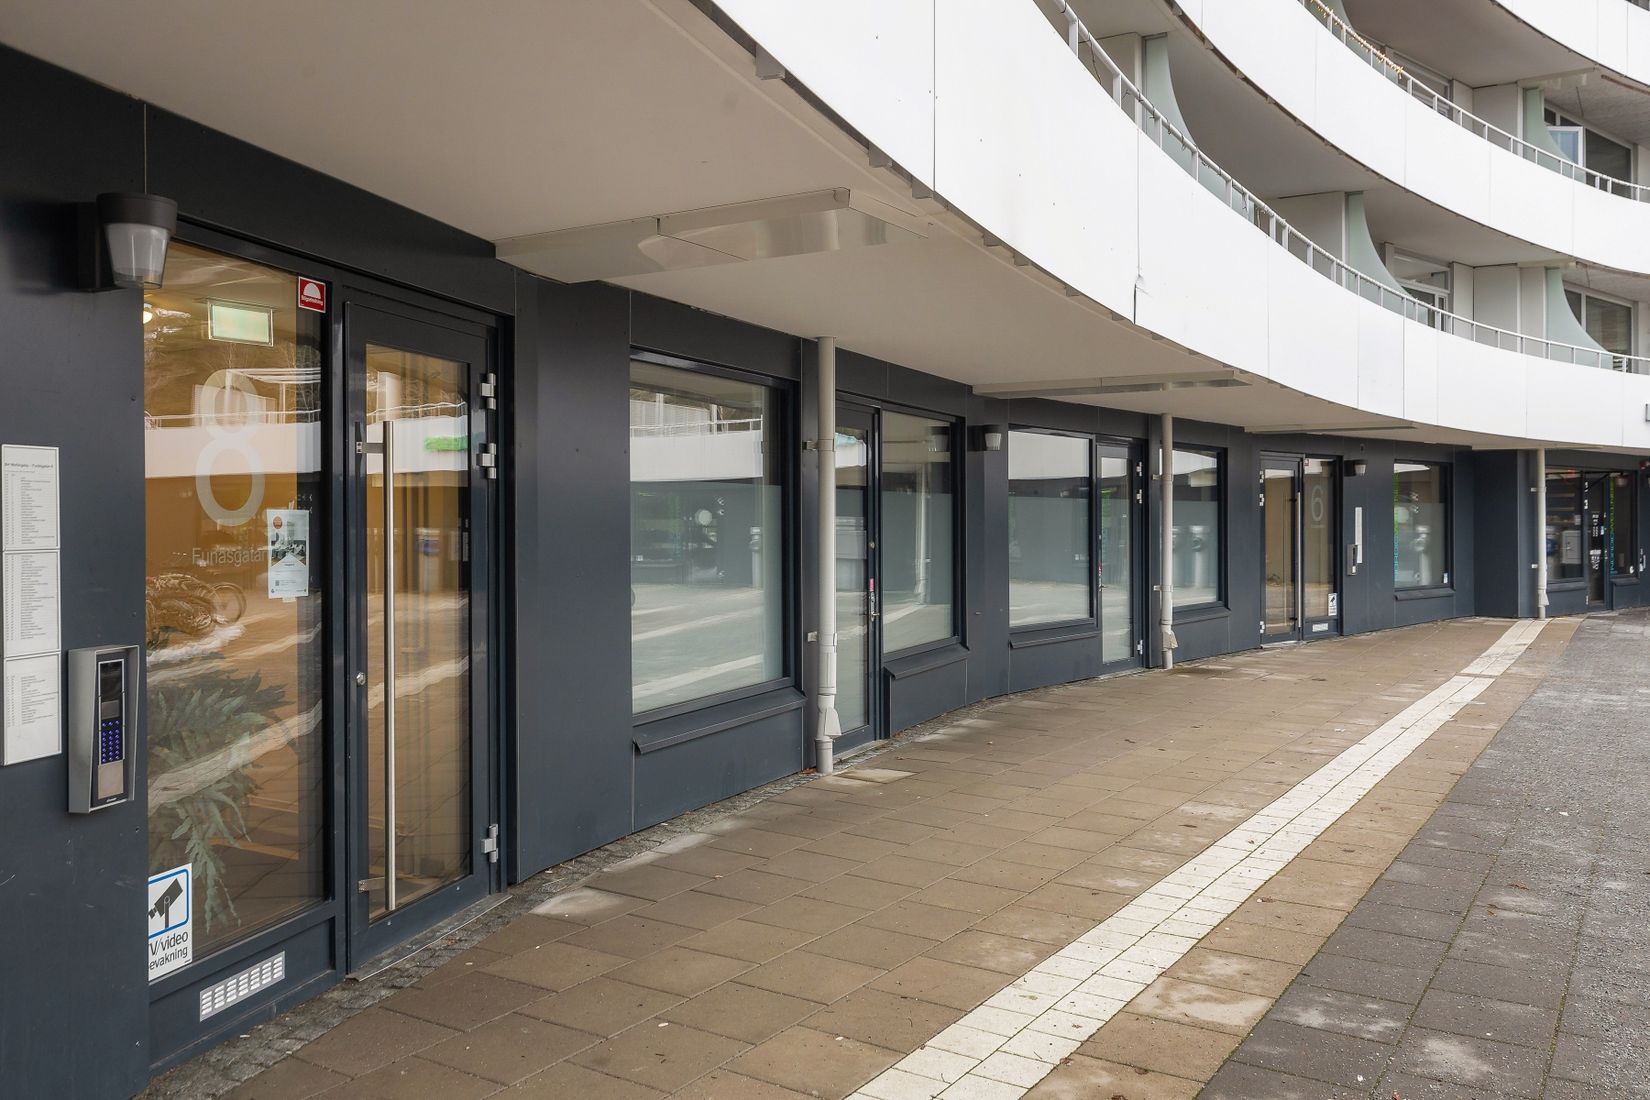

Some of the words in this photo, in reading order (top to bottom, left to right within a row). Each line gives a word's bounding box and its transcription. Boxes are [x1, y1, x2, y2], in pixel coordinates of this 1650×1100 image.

[195, 368, 265, 527] 8
[1311, 484, 1324, 522] 6
[148, 931, 189, 956] V/video
[149, 946, 188, 970] evakning
